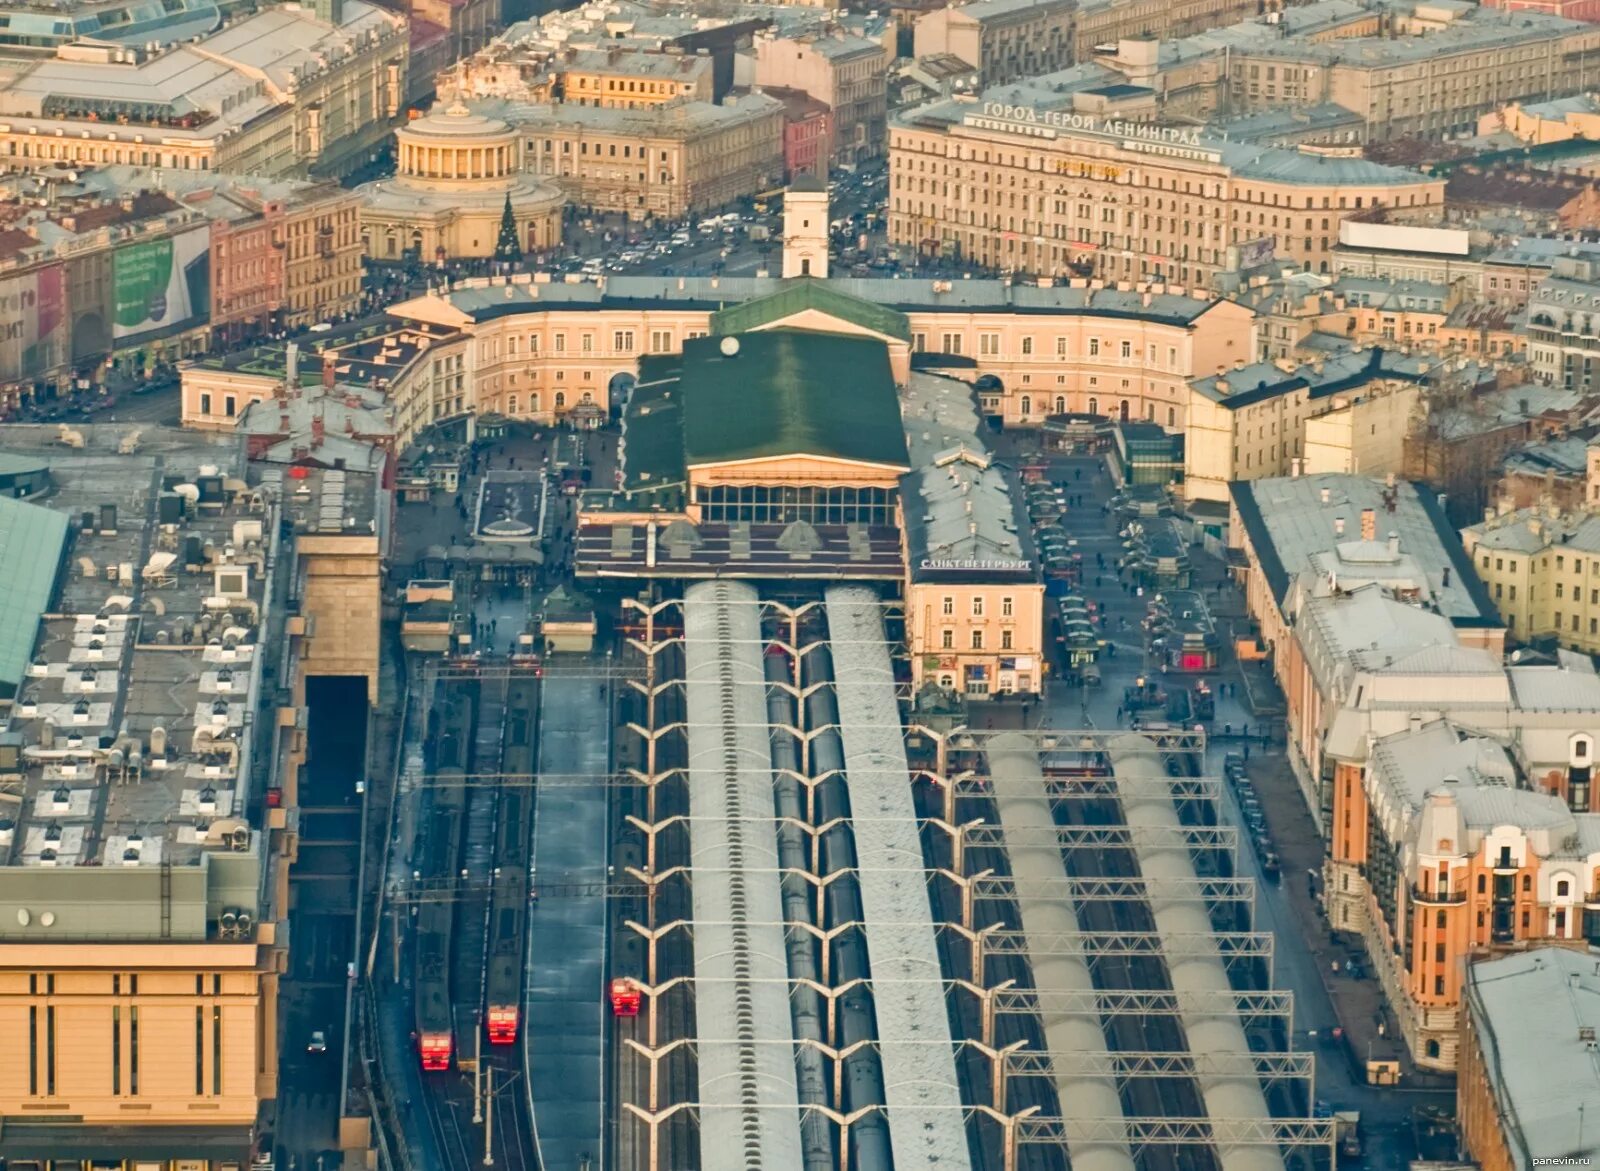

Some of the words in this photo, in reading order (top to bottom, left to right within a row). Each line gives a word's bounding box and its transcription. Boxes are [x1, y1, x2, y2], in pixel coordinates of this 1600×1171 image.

[983, 102, 1094, 130] ГОРОД-ГЕРОЙ
[1103, 120, 1201, 146] ЛЕНИНГРАД
[920, 559, 1032, 568] САНКТ-ПЕТЕРБУРГ
